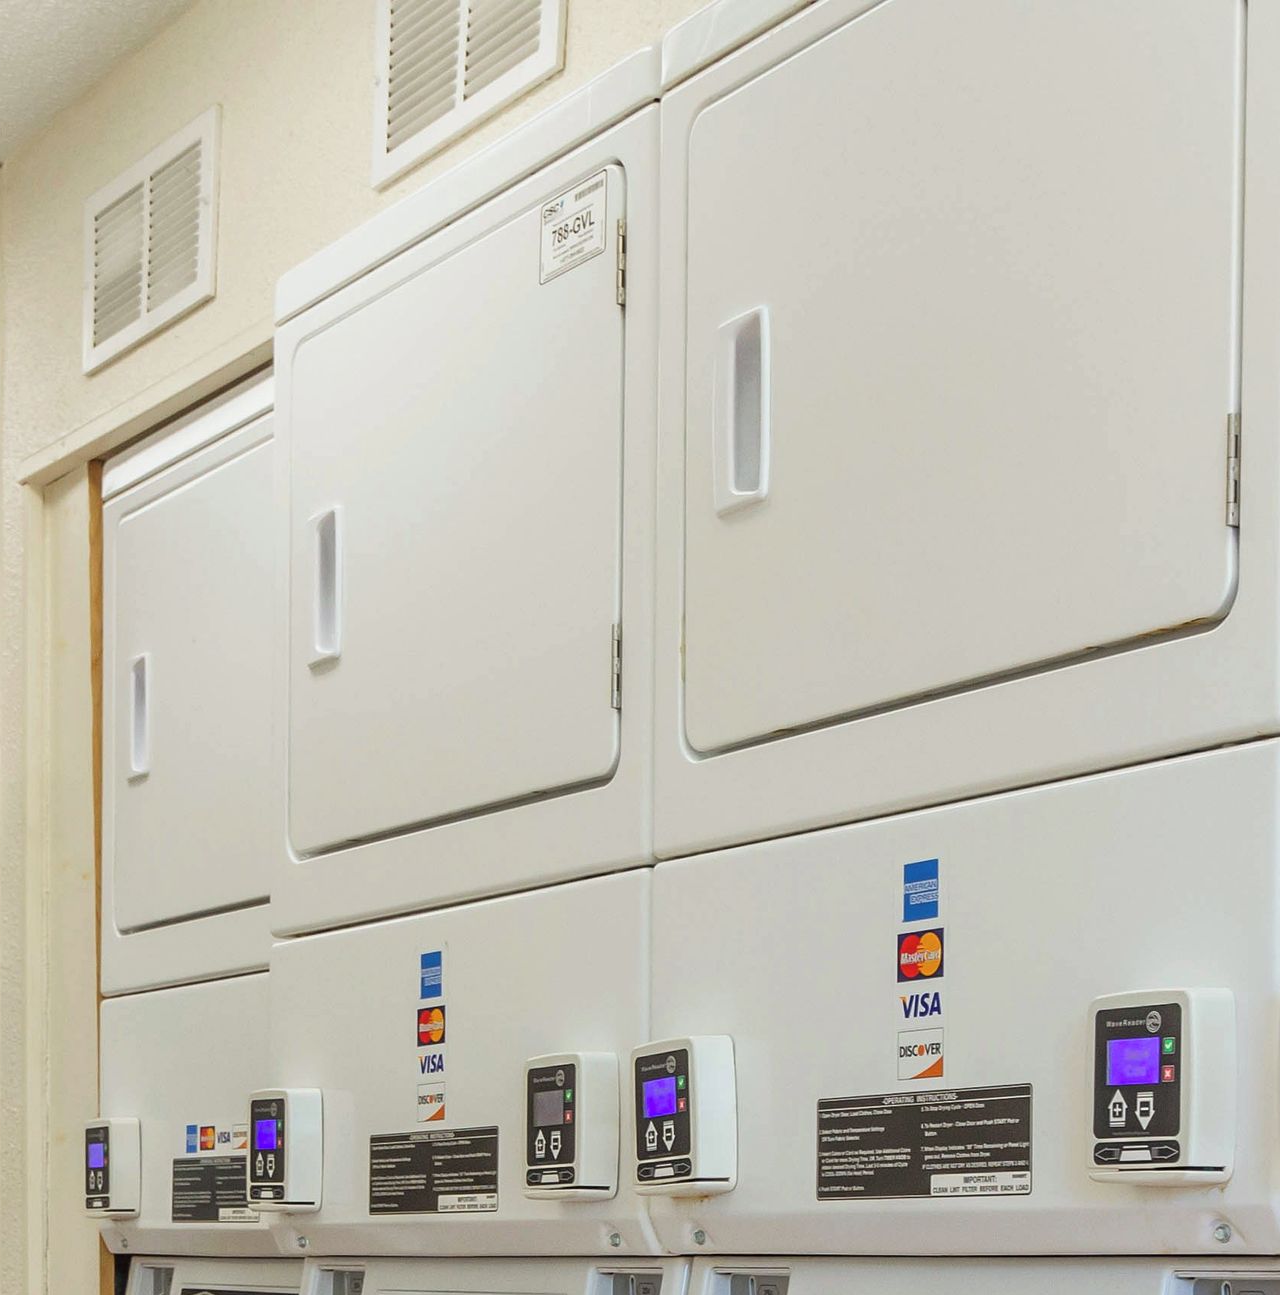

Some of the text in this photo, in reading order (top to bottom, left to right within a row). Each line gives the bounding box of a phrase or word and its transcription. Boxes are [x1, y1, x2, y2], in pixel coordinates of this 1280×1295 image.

[900, 949, 941, 966] MasterCard
[899, 991, 942, 1019] VISA
[899, 1043, 942, 1059] DISCOVER
[418, 1053, 444, 1074] VISA
[418, 1093, 444, 1106] DISCOVER
[217, 1132, 231, 1144] VISA
